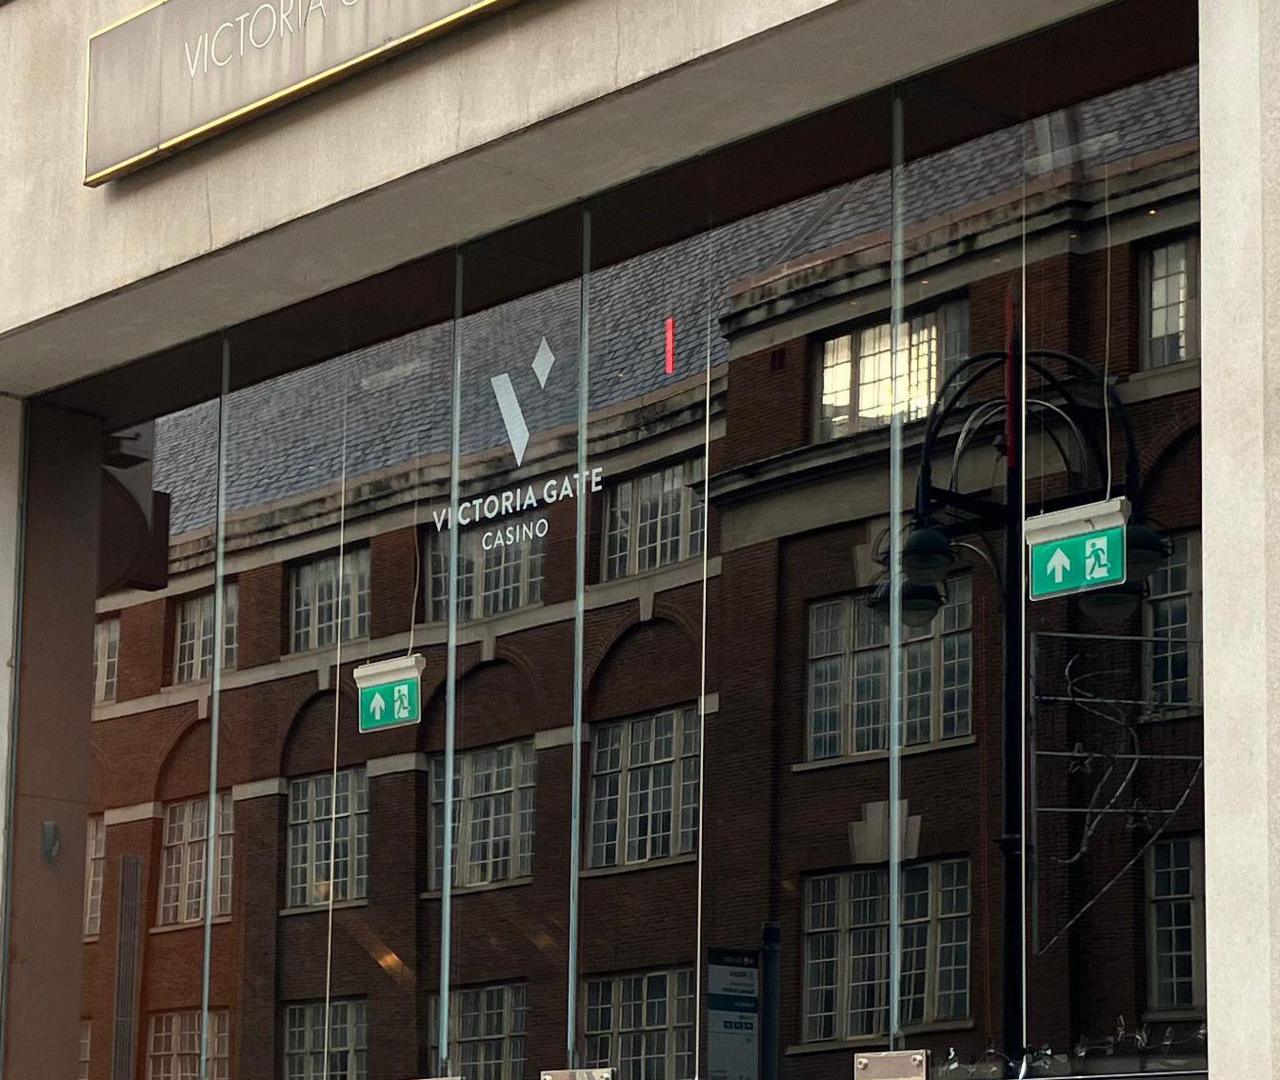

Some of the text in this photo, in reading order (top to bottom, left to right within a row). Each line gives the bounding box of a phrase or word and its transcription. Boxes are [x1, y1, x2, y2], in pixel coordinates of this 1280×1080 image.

[433, 467, 603, 532] VICTORIA GATE
[482, 519, 549, 550] CASINO
